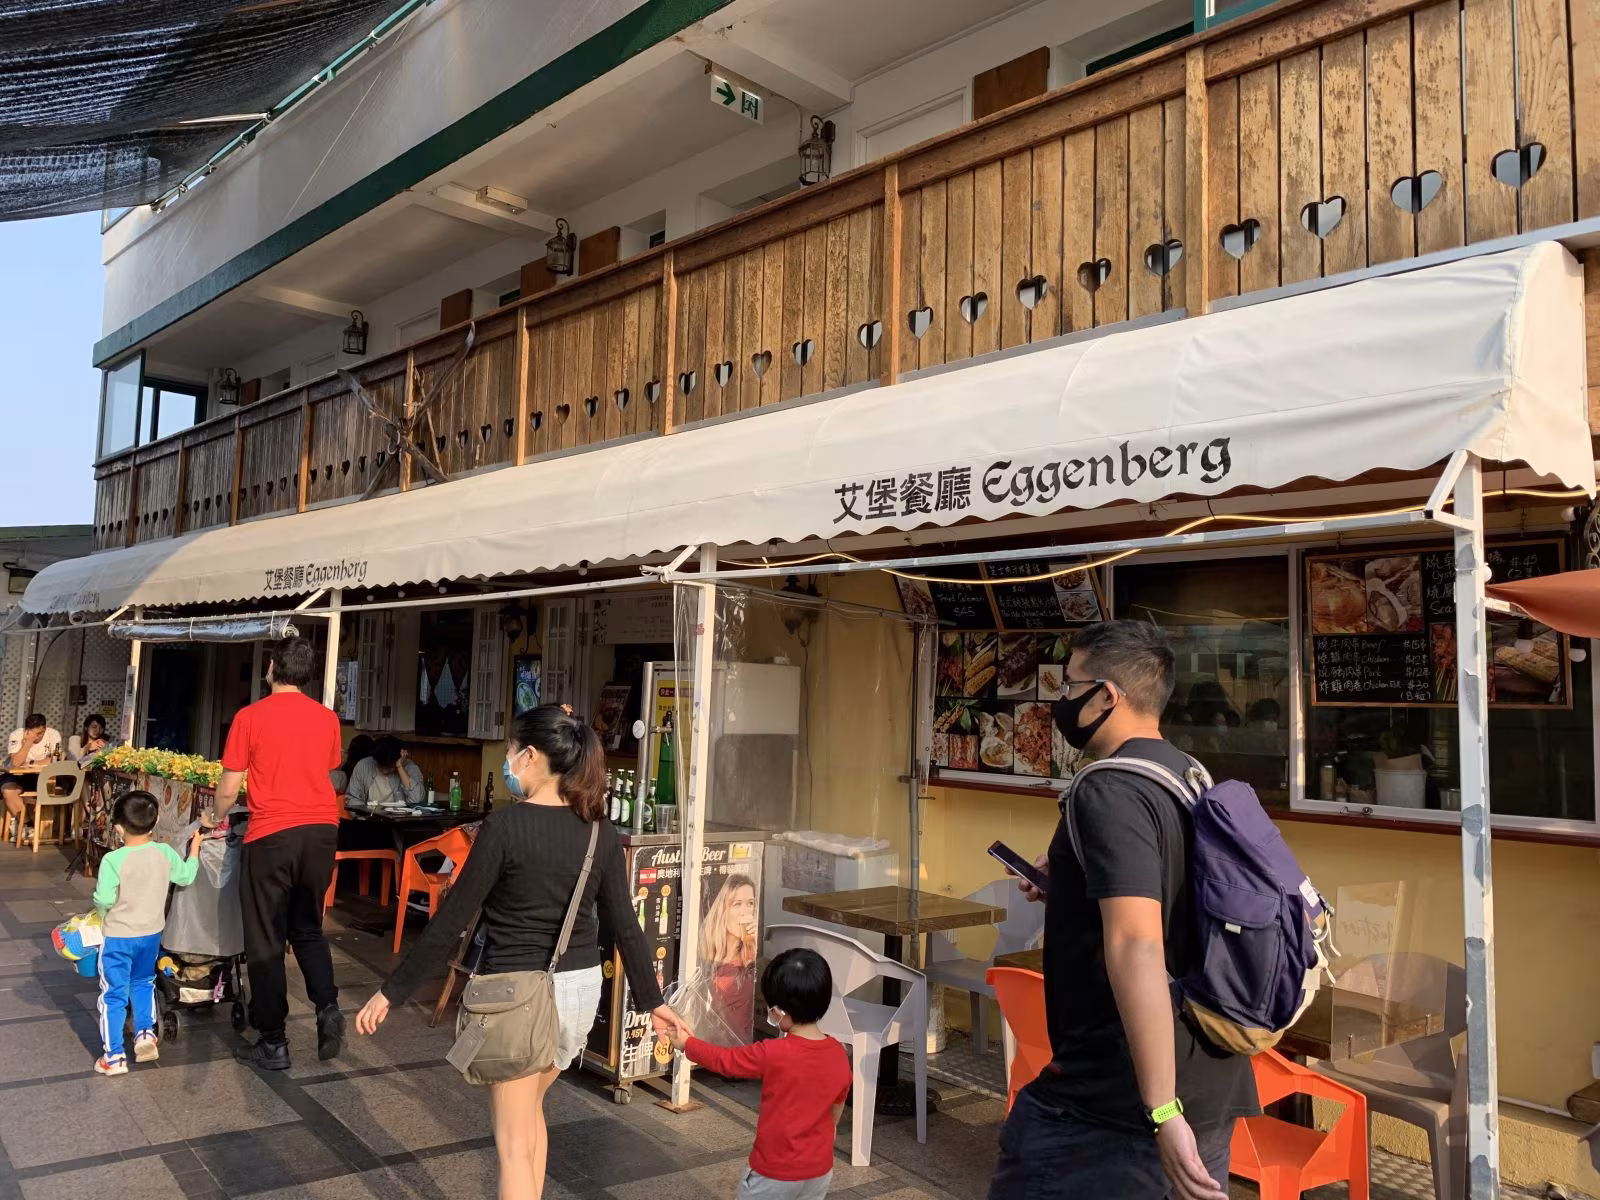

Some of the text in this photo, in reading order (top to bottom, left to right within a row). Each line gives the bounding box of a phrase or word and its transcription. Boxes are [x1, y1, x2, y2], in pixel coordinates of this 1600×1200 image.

[832, 436, 1232, 525] 艾堡餐廳 Eggenberg
[263, 559, 368, 591] 艾堡餐廳 Eggenberg
[651, 847, 726, 867] Aust Beer
